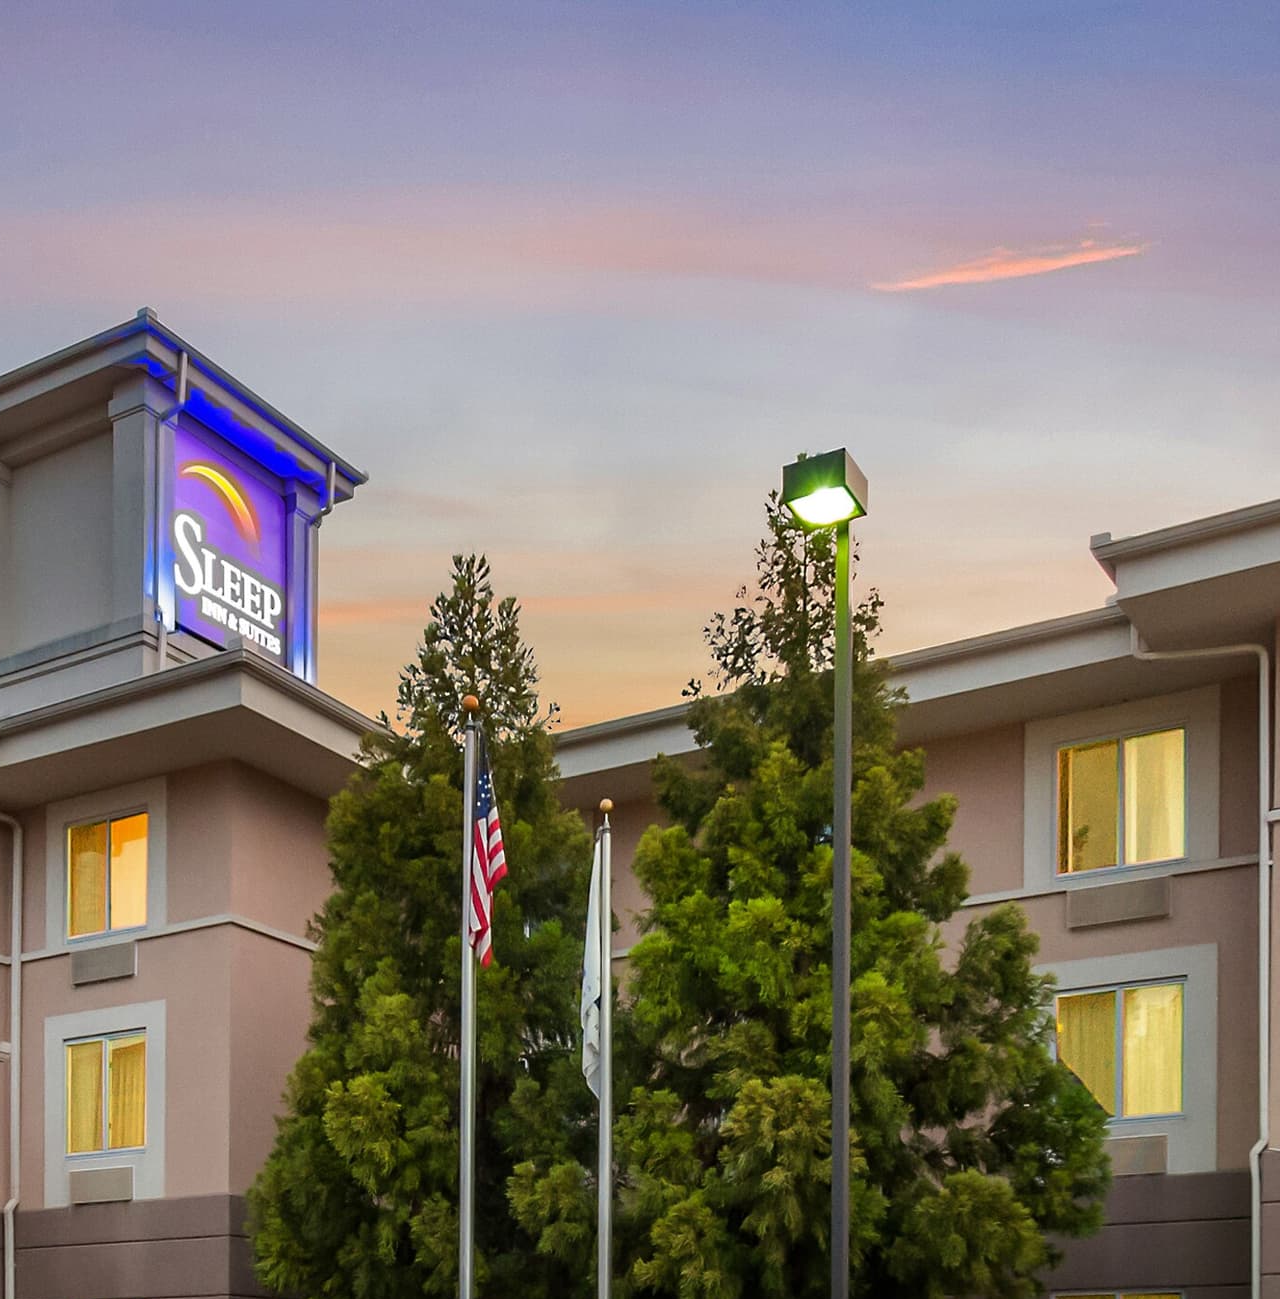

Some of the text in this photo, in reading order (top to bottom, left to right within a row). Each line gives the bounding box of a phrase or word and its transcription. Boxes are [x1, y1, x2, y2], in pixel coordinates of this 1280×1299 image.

[174, 514, 281, 629] SLEEP
[202, 596, 227, 625] INN
[239, 617, 281, 655] SUITES
